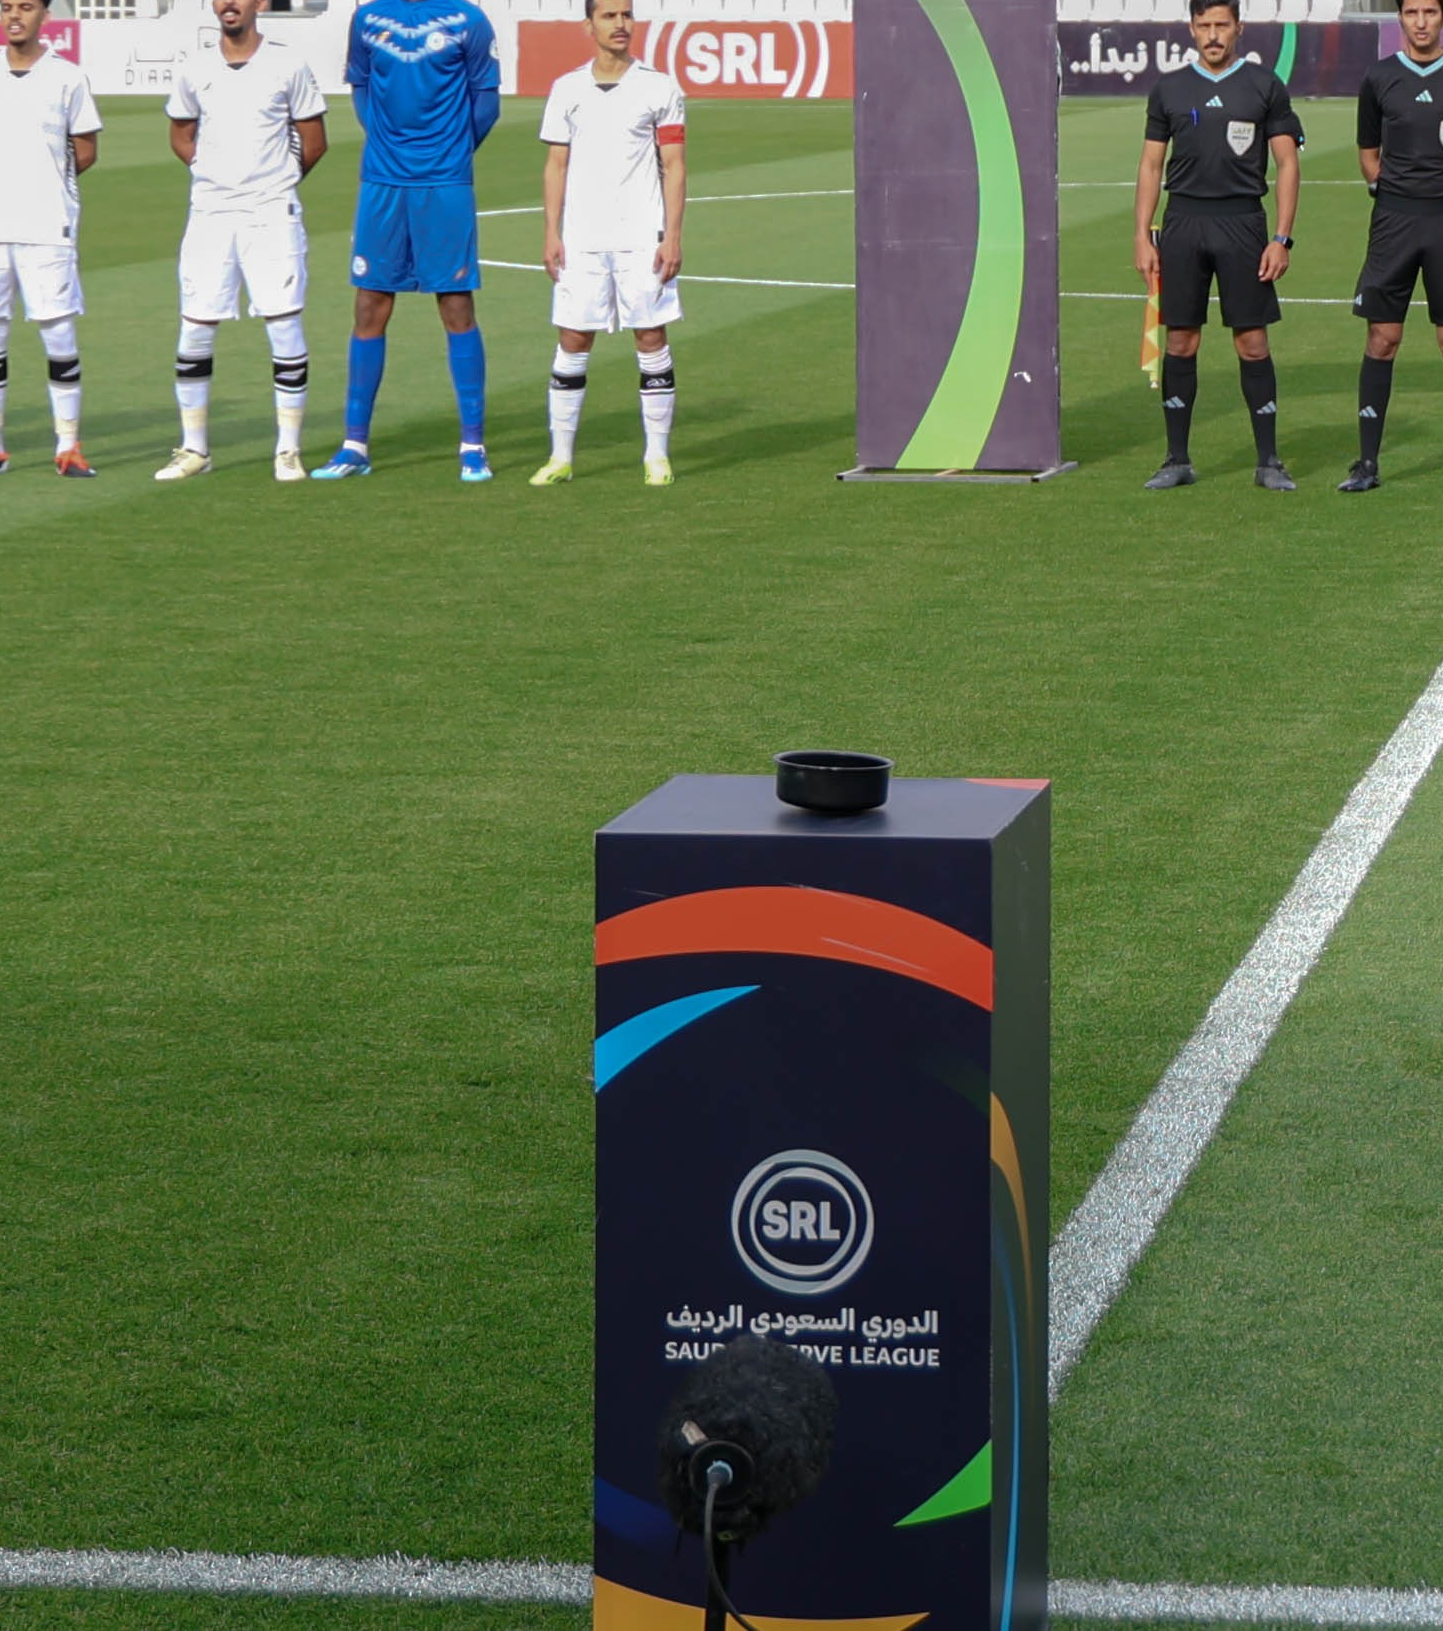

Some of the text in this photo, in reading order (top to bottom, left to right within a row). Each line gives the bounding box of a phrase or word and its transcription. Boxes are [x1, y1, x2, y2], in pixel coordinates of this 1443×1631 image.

[684, 31, 788, 85] SRL
[761, 1200, 841, 1240] SRL
[666, 1304, 939, 1343] الدوري السعودي الرديف
[850, 1345, 941, 1367] LEAGUE
